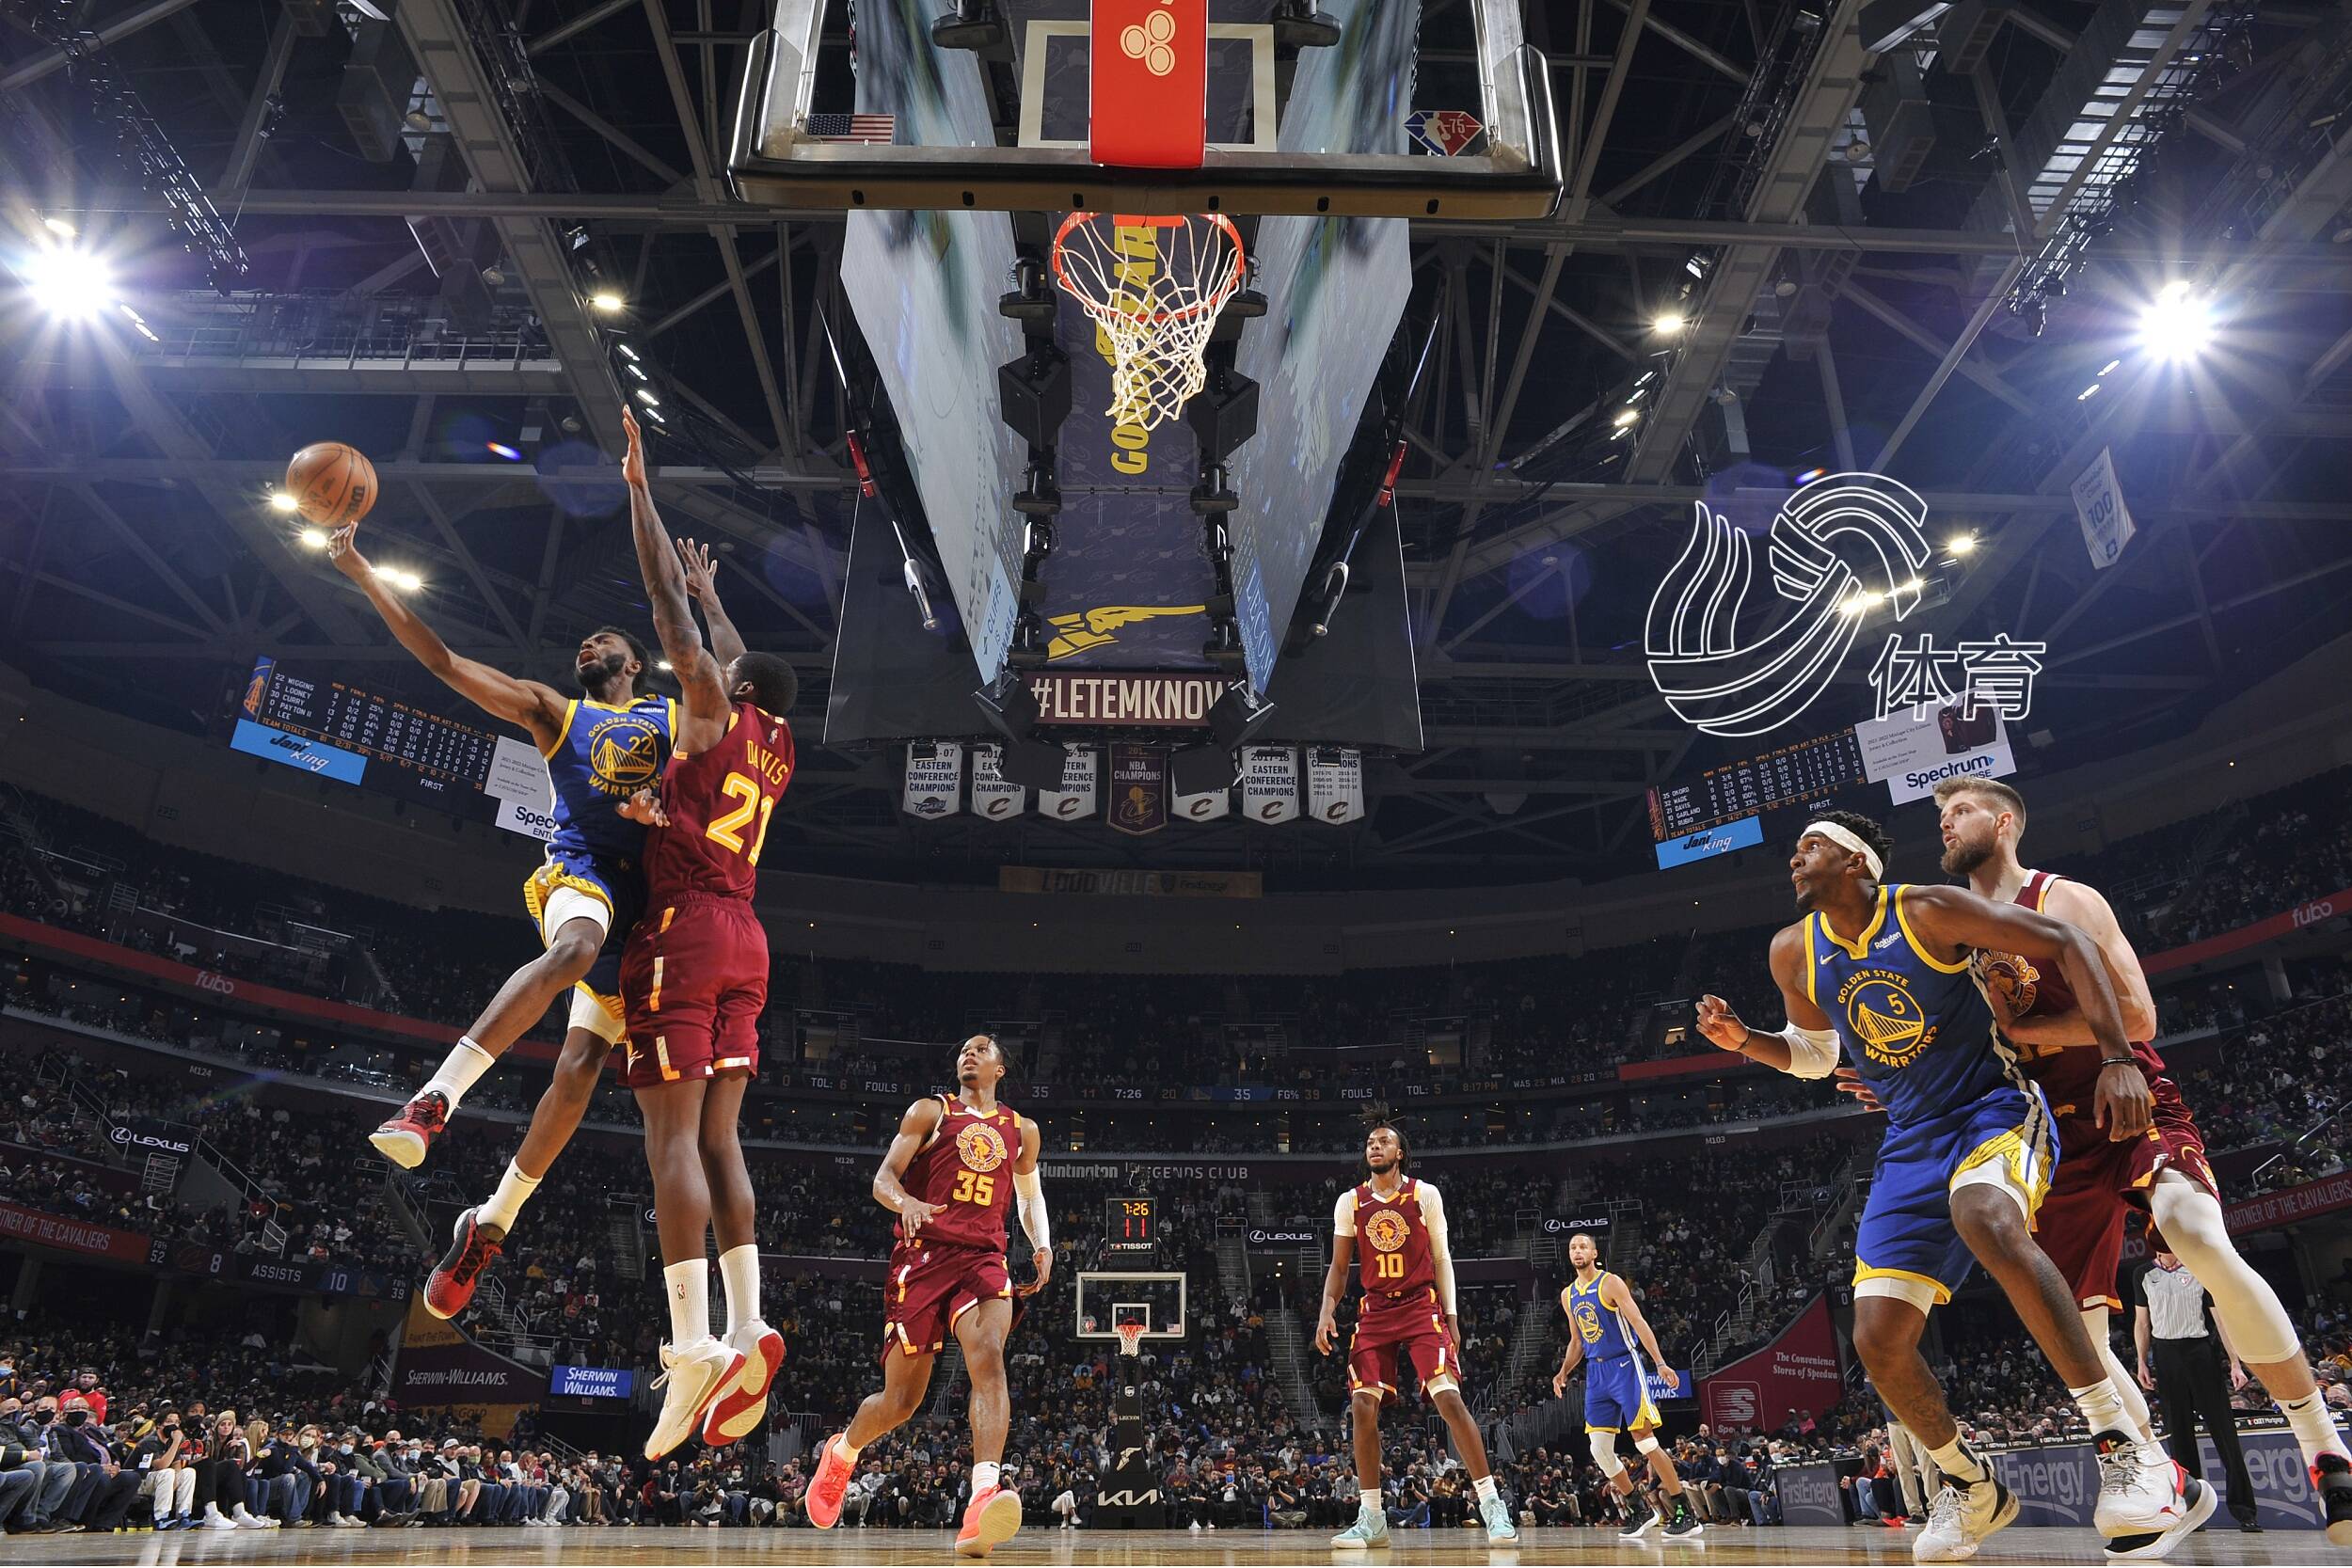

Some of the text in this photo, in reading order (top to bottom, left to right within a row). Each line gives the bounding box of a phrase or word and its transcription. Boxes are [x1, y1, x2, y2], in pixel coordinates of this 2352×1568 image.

[1449, 119, 1466, 134] 75
[2089, 491, 2112, 529] 100
[987, 578, 1002, 634] CLIFFS
[276, 673, 285, 682] 22
[288, 677, 315, 691] WIGGINS
[282, 694, 306, 705] CURRY
[285, 686, 312, 700] LOONEY
[278, 711, 292, 721] LEE
[279, 703, 306, 716] PAYTON
[263, 718, 308, 736] TEAM TOTALS
[588, 716, 628, 737] GOLDEN
[628, 736, 653, 755] 22
[746, 739, 788, 786] DAVIS
[915, 761, 952, 770] EASTERN
[1129, 761, 1147, 771] NBA
[1252, 765, 1289, 775] EASTERN
[908, 771, 959, 782] CONFERENCE
[1114, 770, 1161, 782] CHAMPIONS
[1906, 755, 1989, 789] Spectrum
[909, 783, 956, 793] CHAMPIONS
[976, 783, 1021, 793] CHAMPIONS
[1245, 776, 1296, 786] CONFERENCE
[1248, 787, 1295, 798] CHAMPIONS
[1675, 802, 1691, 812] DAVIS
[1676, 807, 1701, 819] GARLAND
[706, 771, 775, 867] 21
[2292, 901, 2333, 928] fubo
[1874, 931, 1902, 950] Rakuten
[194, 971, 234, 994] fubo
[1836, 969, 1909, 1005] GOLDEN STATE
[1886, 992, 1906, 1016] 5
[1864, 1025, 1939, 1069] WARRIORS
[865, 1081, 898, 1093] FOULS
[1031, 1086, 1050, 1098] 35
[1114, 1088, 1143, 1100] 7:26
[1234, 1088, 1251, 1101] 35
[1278, 1089, 1300, 1100] FG%
[1341, 1088, 1374, 1100] FOULS
[1406, 1085, 1429, 1096] TOL:
[1513, 1079, 1531, 1088] WAS
[133, 1133, 190, 1153] LEXUS
[1705, 1135, 1726, 1145] M103
[1039, 1161, 1119, 1180] Huntington
[952, 1169, 995, 1207] 35
[2261, 1201, 2277, 1220] OF
[2278, 1195, 2297, 1216] THE
[2297, 1180, 2352, 1212] CAVALIERS
[1122, 1202, 1149, 1216] 7:26
[1560, 1217, 1609, 1229] LEXUS
[23, 1214, 36, 1229] OF
[36, 1218, 55, 1234] THE
[55, 1221, 110, 1251] CAVALIERS
[1266, 1232, 1313, 1242] LEXUS
[150, 1249, 167, 1264] 52
[209, 1253, 347, 1291] 8 ASSISTS 10
[1375, 1253, 1405, 1279] 10
[390, 1287, 405, 1301] 39
[1776, 1351, 1836, 1366] The Convenience
[566, 1367, 618, 1383] SHERWIN
[1772, 1365, 1796, 1376] Stores
[1798, 1367, 1806, 1378] of
[1098, 1488, 1158, 1507] KIA
[1781, 1477, 1839, 1512] FirstEnergy
